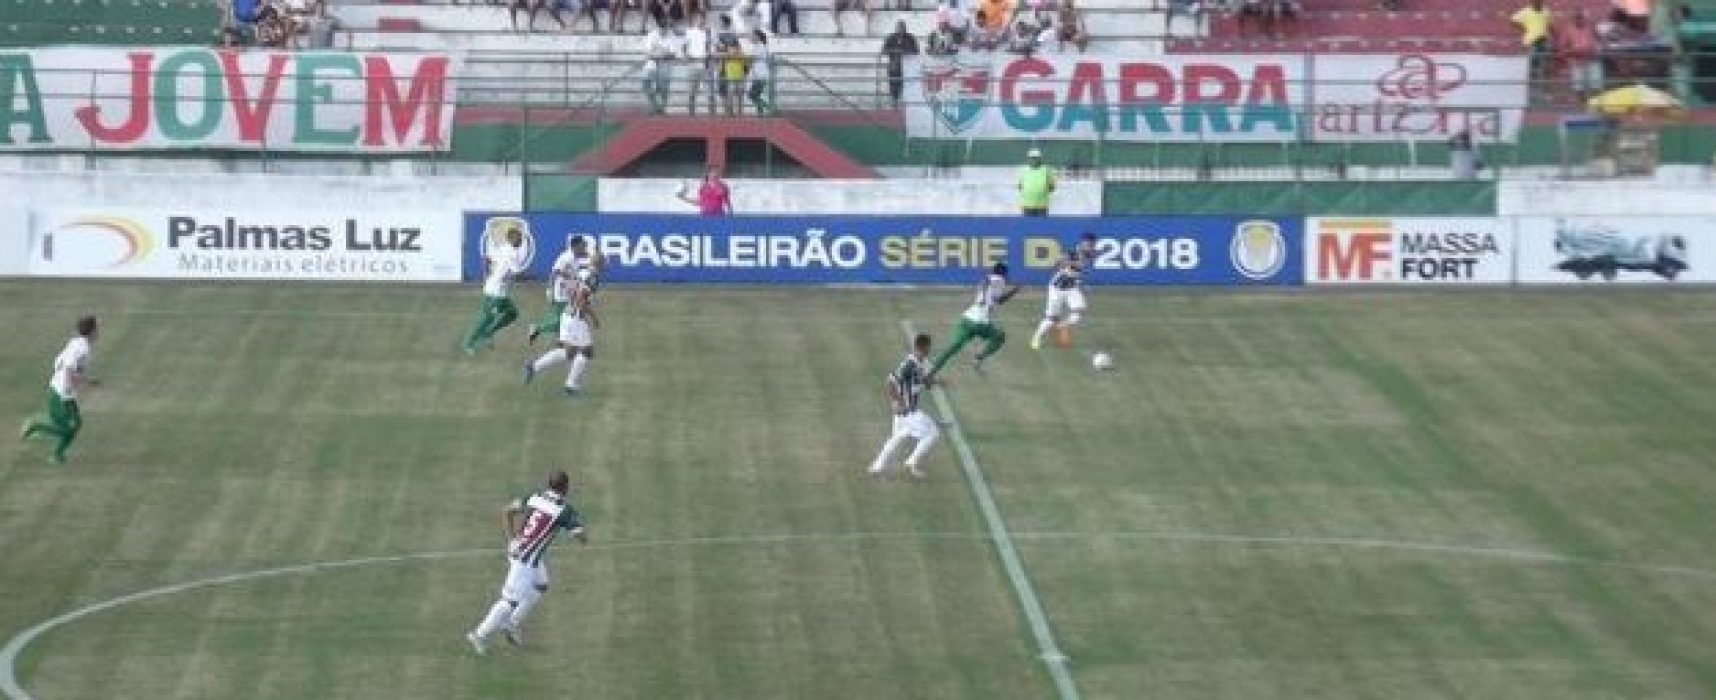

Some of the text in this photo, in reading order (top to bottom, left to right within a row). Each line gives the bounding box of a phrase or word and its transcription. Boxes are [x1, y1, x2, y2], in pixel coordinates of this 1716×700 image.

[74, 48, 450, 146] JOVEM
[1000, 57, 1296, 132] GARRA
[168, 216, 422, 251] Palmas Luz
[880, 229, 1008, 269] SÉRIE
[1024, 238, 1060, 269] D
[1093, 237, 1198, 269] 2018
[1402, 232, 1499, 254] MASSA
[178, 253, 409, 274] Materiais elétricos
[1318, 233, 1392, 280] MF
[1402, 258, 1478, 280] FORT
